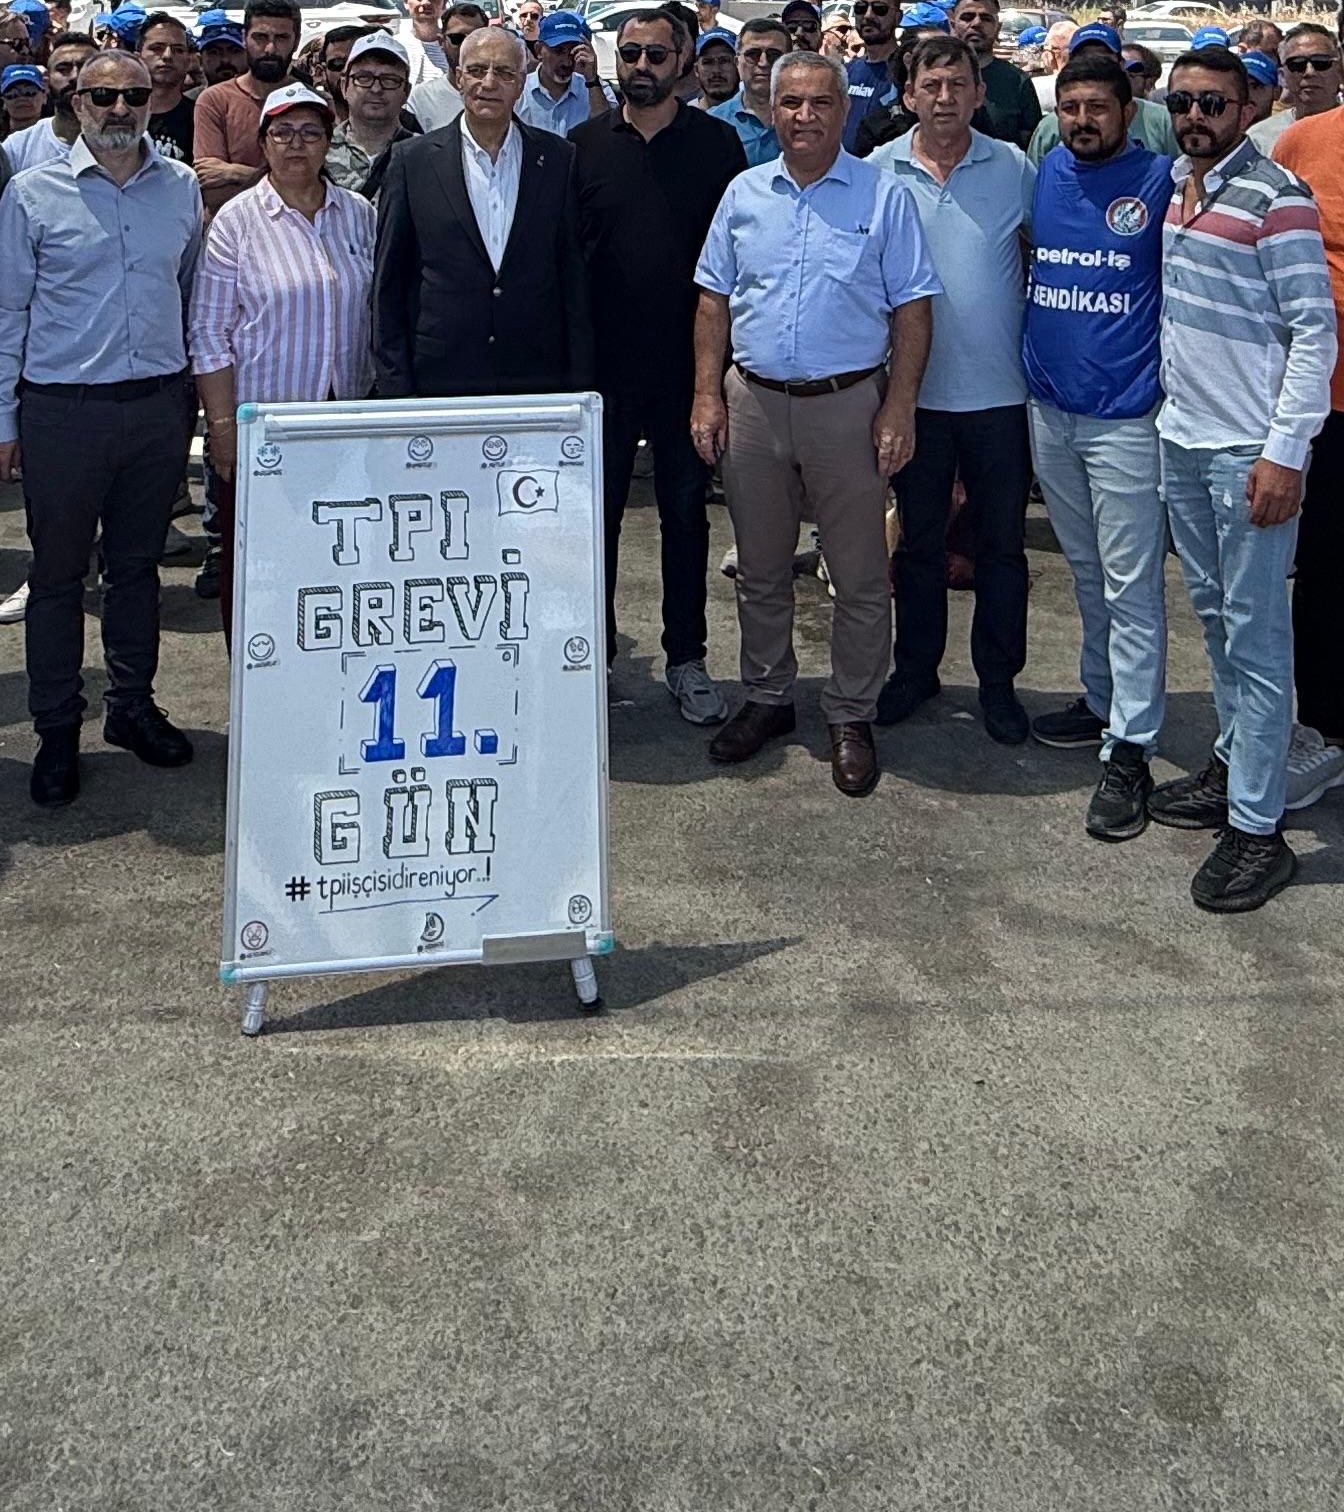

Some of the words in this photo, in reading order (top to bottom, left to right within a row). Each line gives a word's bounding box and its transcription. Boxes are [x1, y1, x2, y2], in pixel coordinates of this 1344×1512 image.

[1033, 285, 1131, 315] SENDİKASI
[1037, 247, 1131, 271] petrol-iş
[312, 491, 469, 565] TPI
[297, 549, 529, 651] GREVİ
[358, 658, 498, 762] 11.
[314, 766, 498, 865] GÜN
